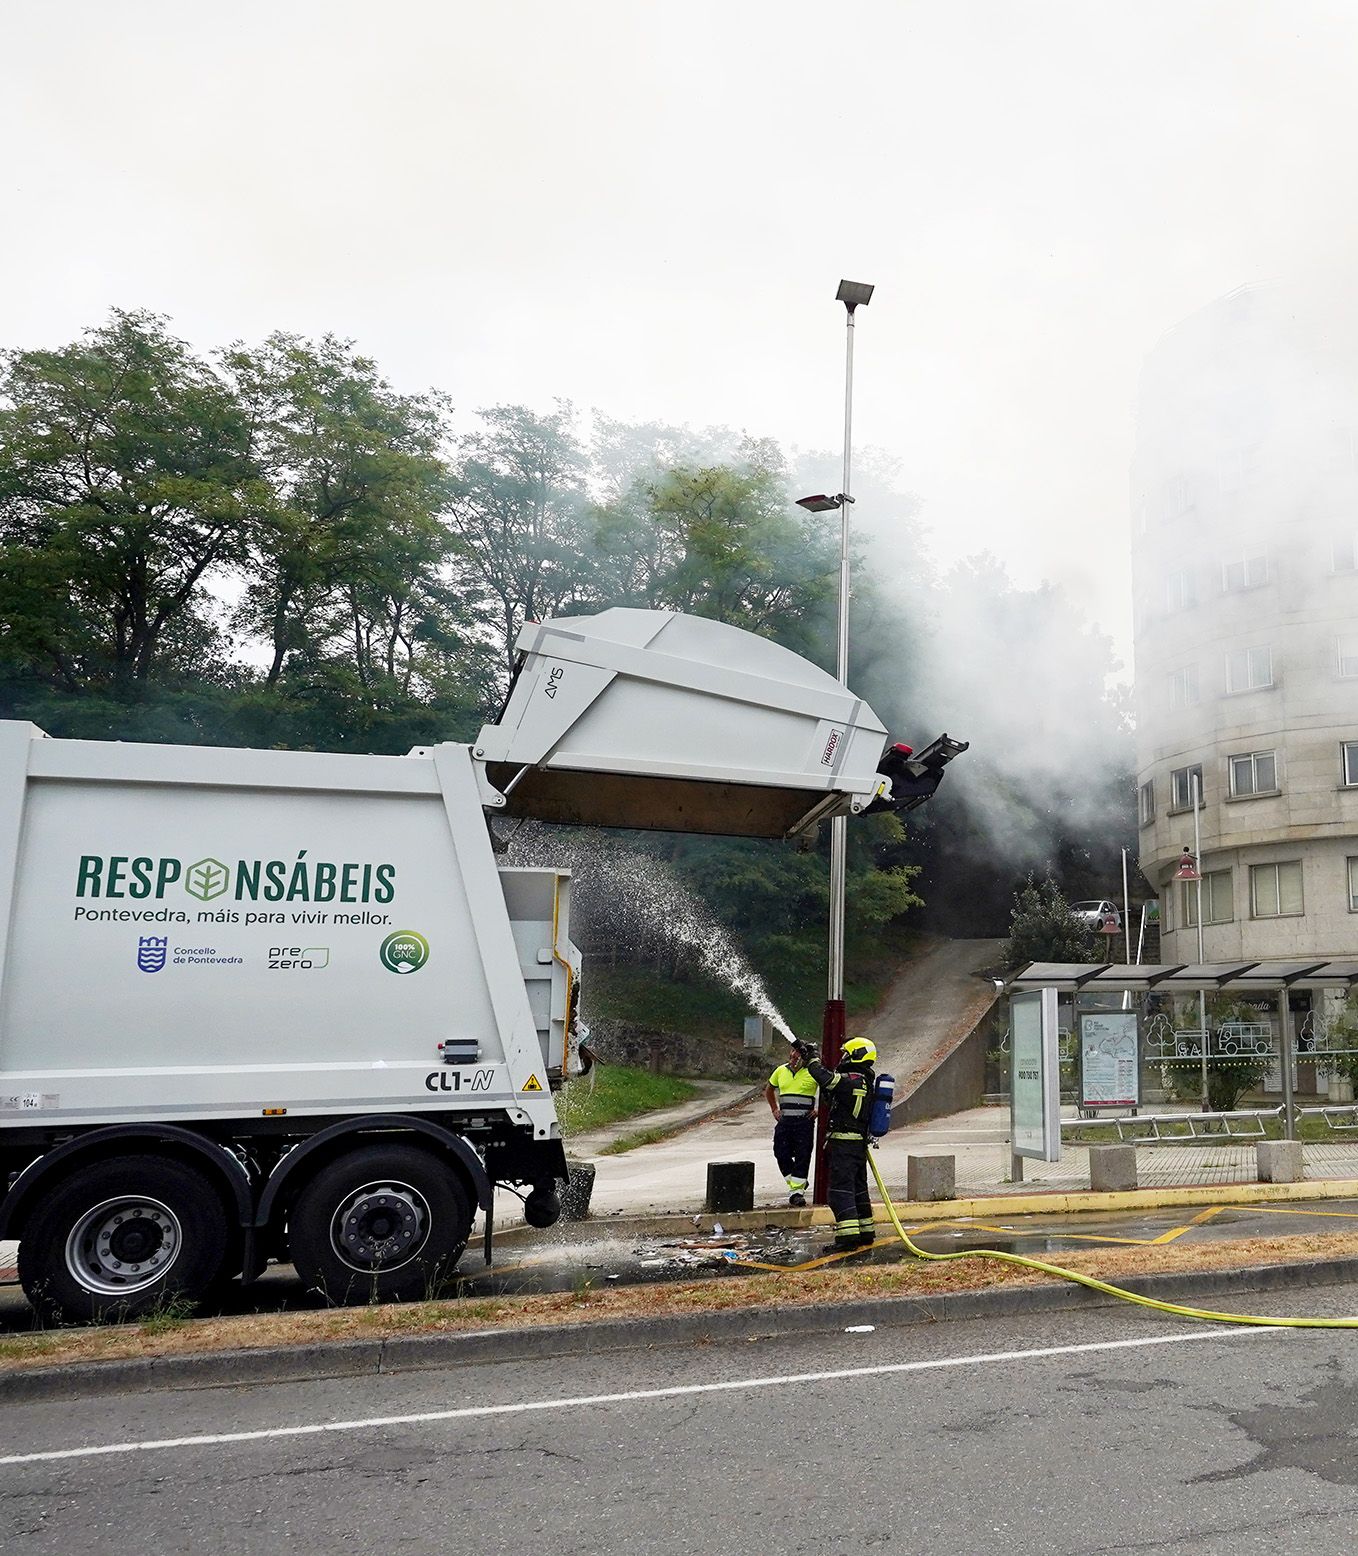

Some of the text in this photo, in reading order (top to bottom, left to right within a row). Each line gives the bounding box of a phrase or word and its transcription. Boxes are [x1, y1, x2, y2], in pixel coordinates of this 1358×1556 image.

[823, 732, 838, 764] HARDOX
[74, 907, 392, 926] Pontevedra, máis para vivir mellor.
[173, 947, 216, 955] Concello
[394, 943, 416, 951] 100%
[268, 947, 302, 959] pre
[392, 950, 416, 960] GNC
[172, 956, 243, 964] de Pontevedra
[268, 959, 312, 969] zero
[425, 1069, 495, 1092] CL1-N
